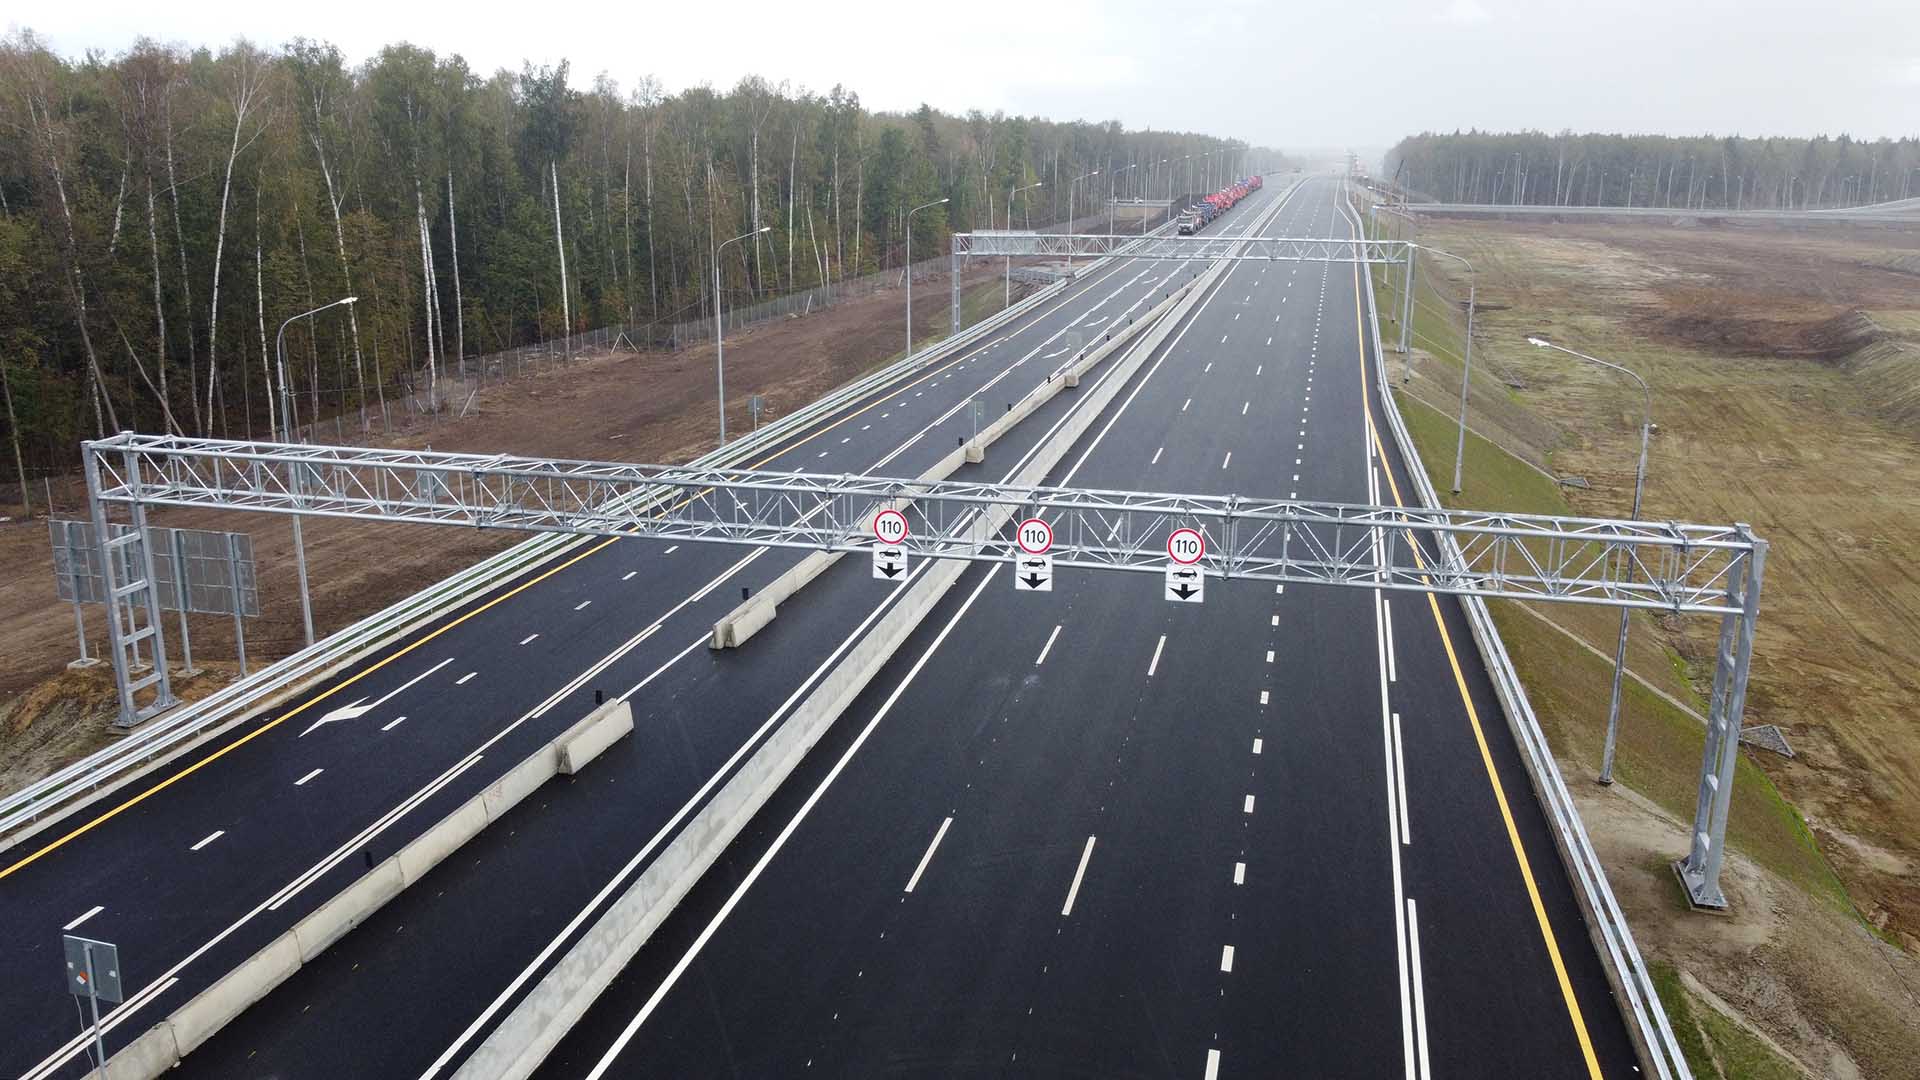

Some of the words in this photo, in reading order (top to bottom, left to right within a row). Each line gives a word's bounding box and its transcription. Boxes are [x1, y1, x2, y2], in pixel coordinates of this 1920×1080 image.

[880, 520, 902, 534] 110
[1024, 529, 1046, 544] 110
[1175, 539, 1198, 554] 110
